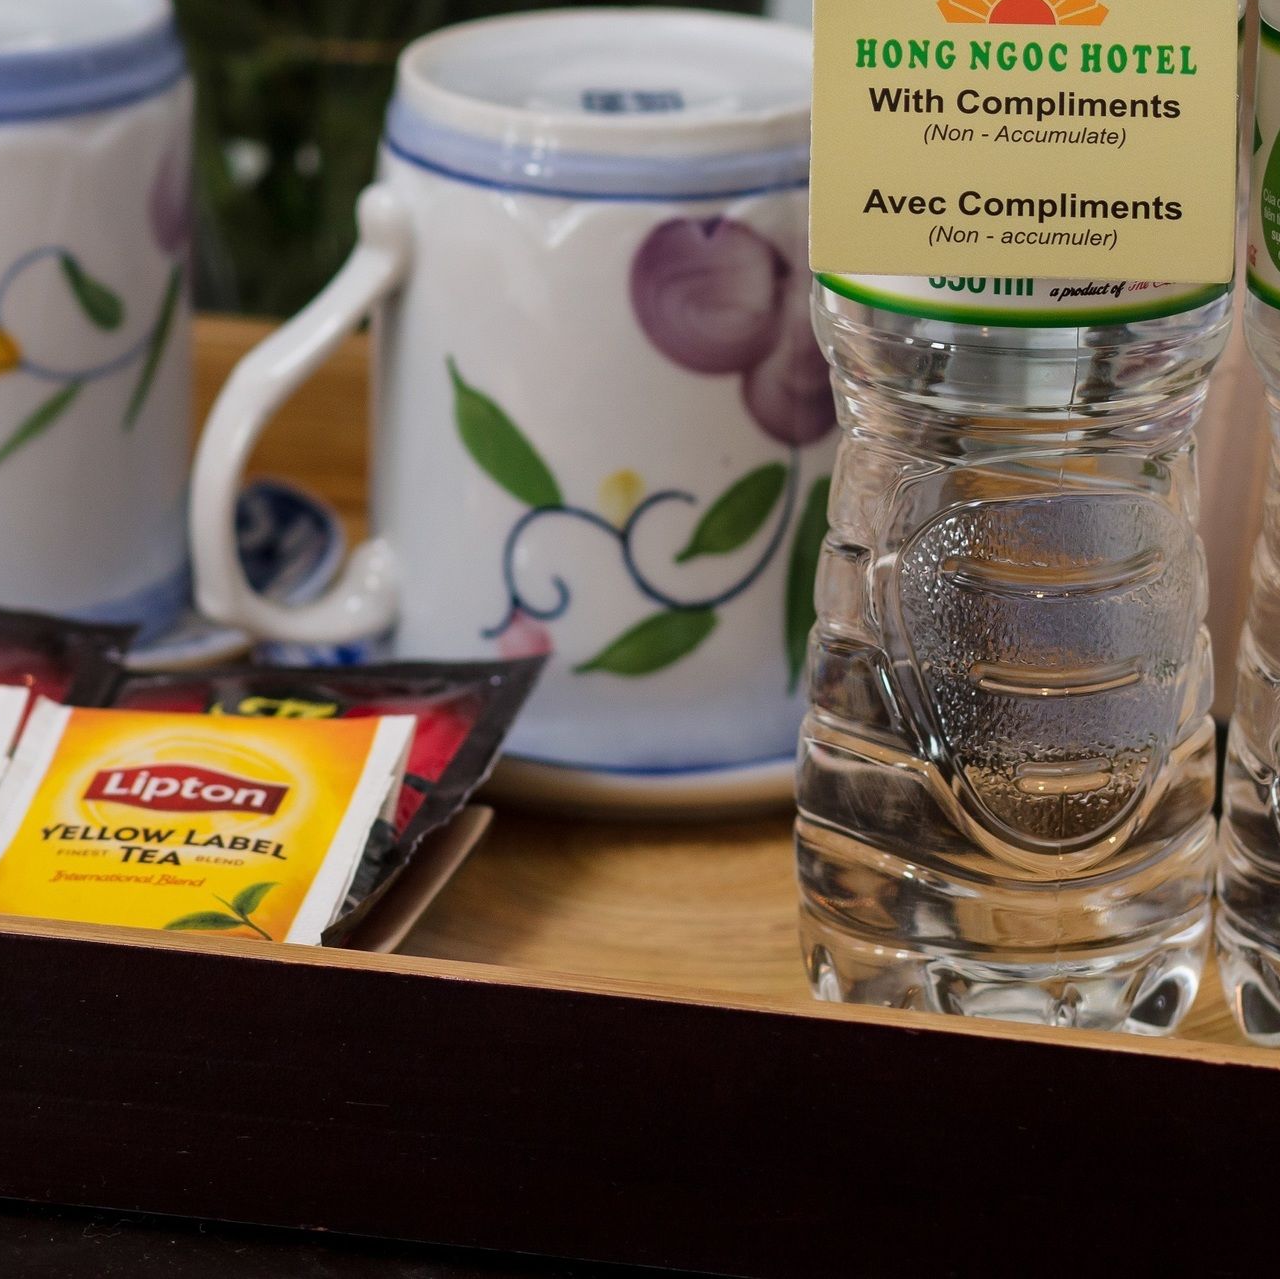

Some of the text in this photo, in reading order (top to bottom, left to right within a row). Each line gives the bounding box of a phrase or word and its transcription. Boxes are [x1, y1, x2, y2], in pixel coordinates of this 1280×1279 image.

[855, 38, 1198, 75] HONG NGOC HOTEL
[869, 87, 1182, 121] With Compliments
[923, 123, 974, 144] (Non
[993, 124, 1127, 148] Accumulate)
[862, 189, 1183, 223] Avec Compliments
[928, 225, 979, 247] (Non
[1000, 227, 1119, 249] accumuler)
[1049, 287, 1058, 297] a
[1058, 282, 1109, 301] product
[1110, 280, 1127, 298] of
[102, 769, 268, 809] Lipton
[41, 823, 289, 861] YELLOW LABEL
[119, 845, 182, 866] TEA
[194, 854, 245, 867] BLEND
[48, 869, 207, 888] International Blend
